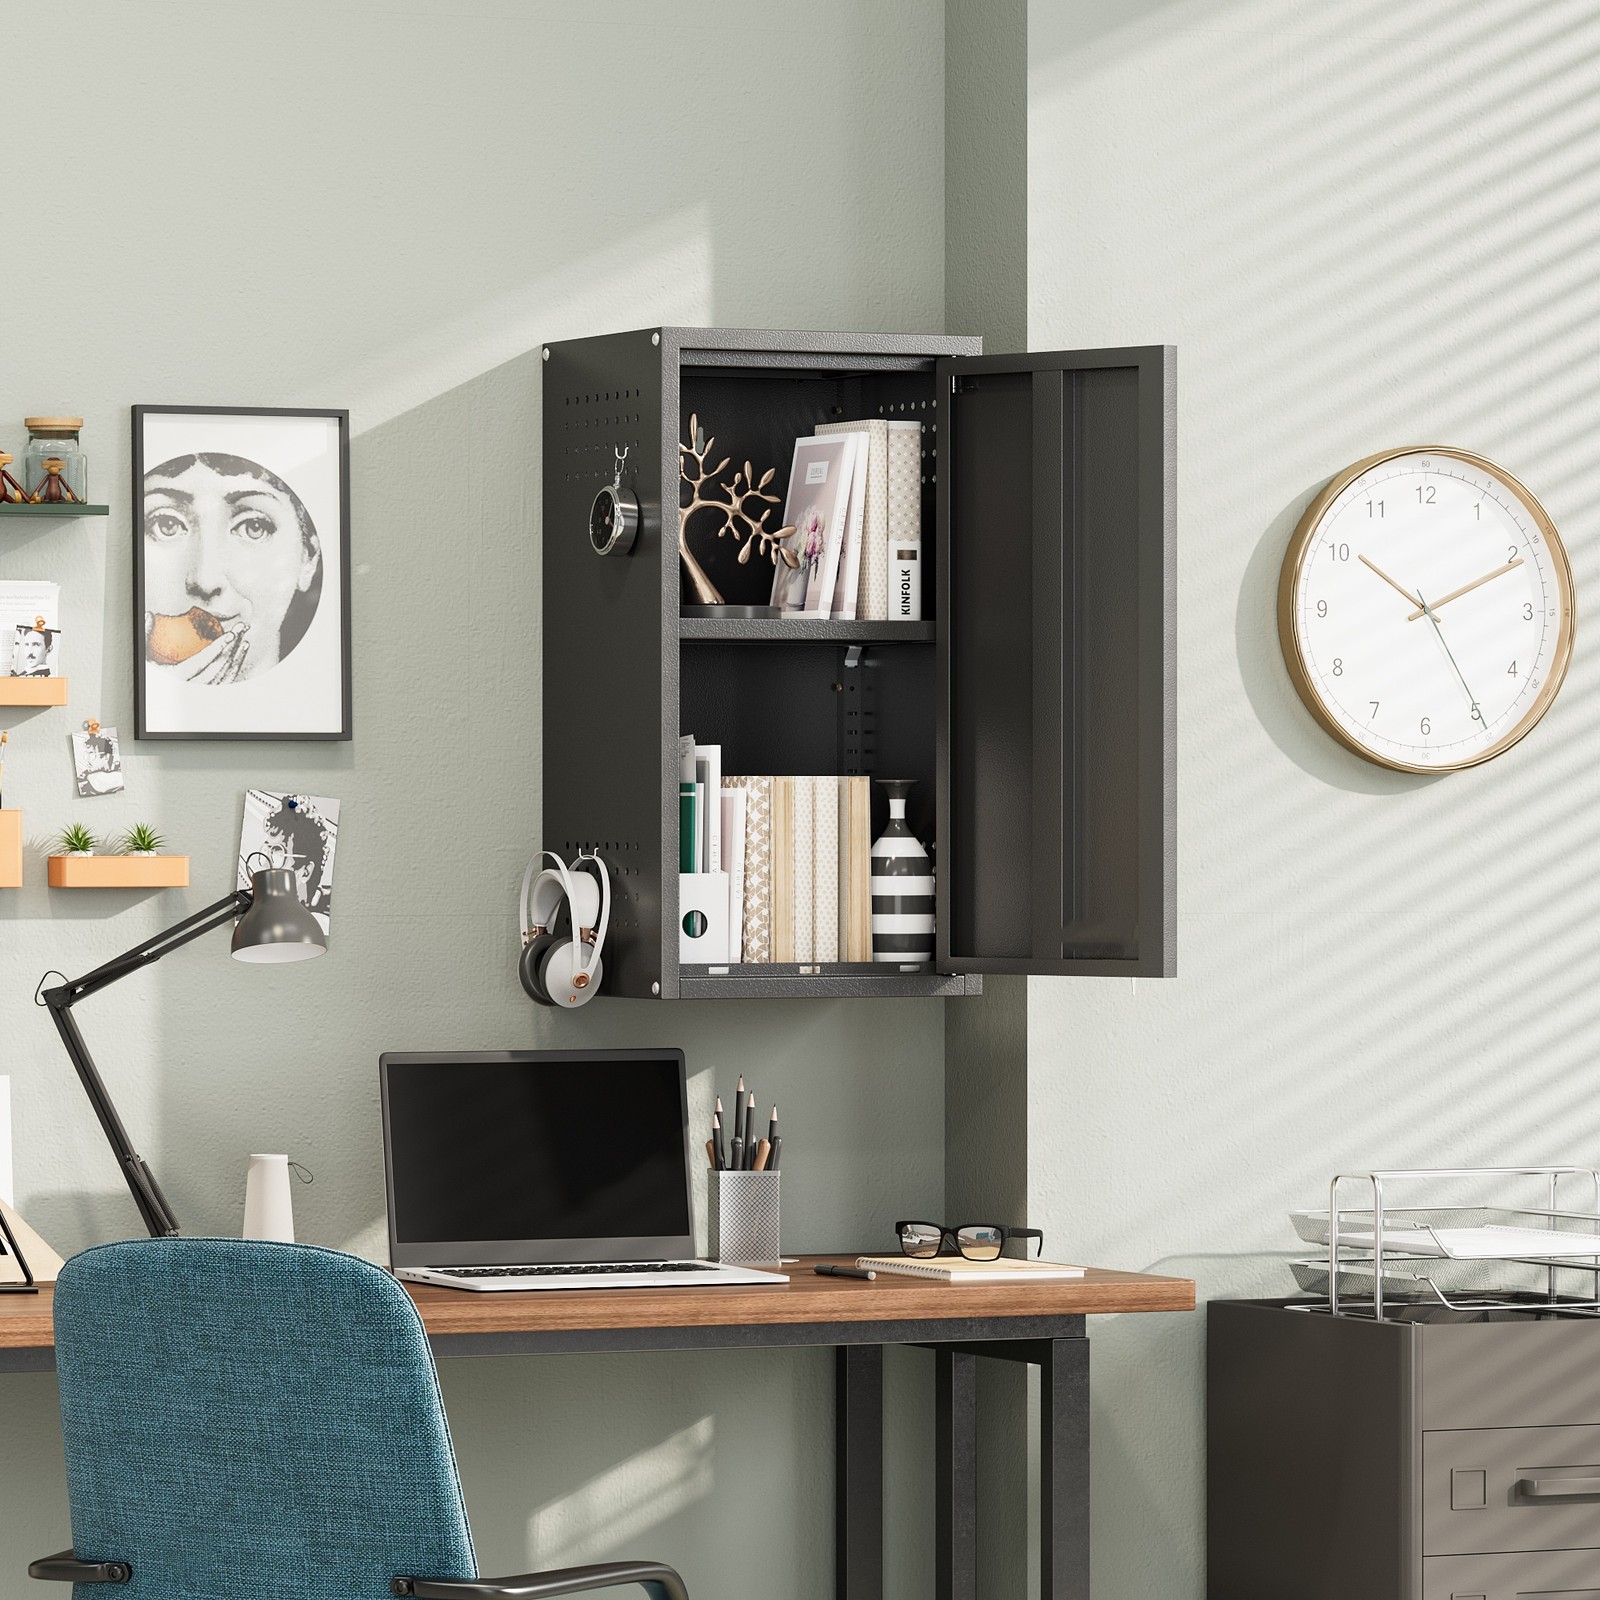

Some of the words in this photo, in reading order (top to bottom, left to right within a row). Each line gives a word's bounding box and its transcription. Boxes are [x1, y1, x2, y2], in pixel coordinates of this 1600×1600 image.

[1421, 460, 1431, 468] 60
[1486, 480, 1493, 489] 5
[1415, 485, 1437, 505] 12
[1365, 499, 1384, 519] 11
[1473, 502, 1480, 521] 1
[1532, 534, 1540, 544] 10
[1328, 542, 1350, 562] 10
[1507, 545, 1519, 564] 2
[901, 569, 911, 615] KINFOLK
[1316, 599, 1328, 619] 9
[1522, 602, 1534, 621] 3
[1548, 608, 1556, 617] 15
[1332, 657, 1344, 677] 8
[1507, 660, 1519, 678] 4
[1531, 678, 1540, 689] 20
[1369, 701, 1380, 720] 7
[1470, 701, 1481, 721] 5
[1420, 716, 1431, 736] 6
